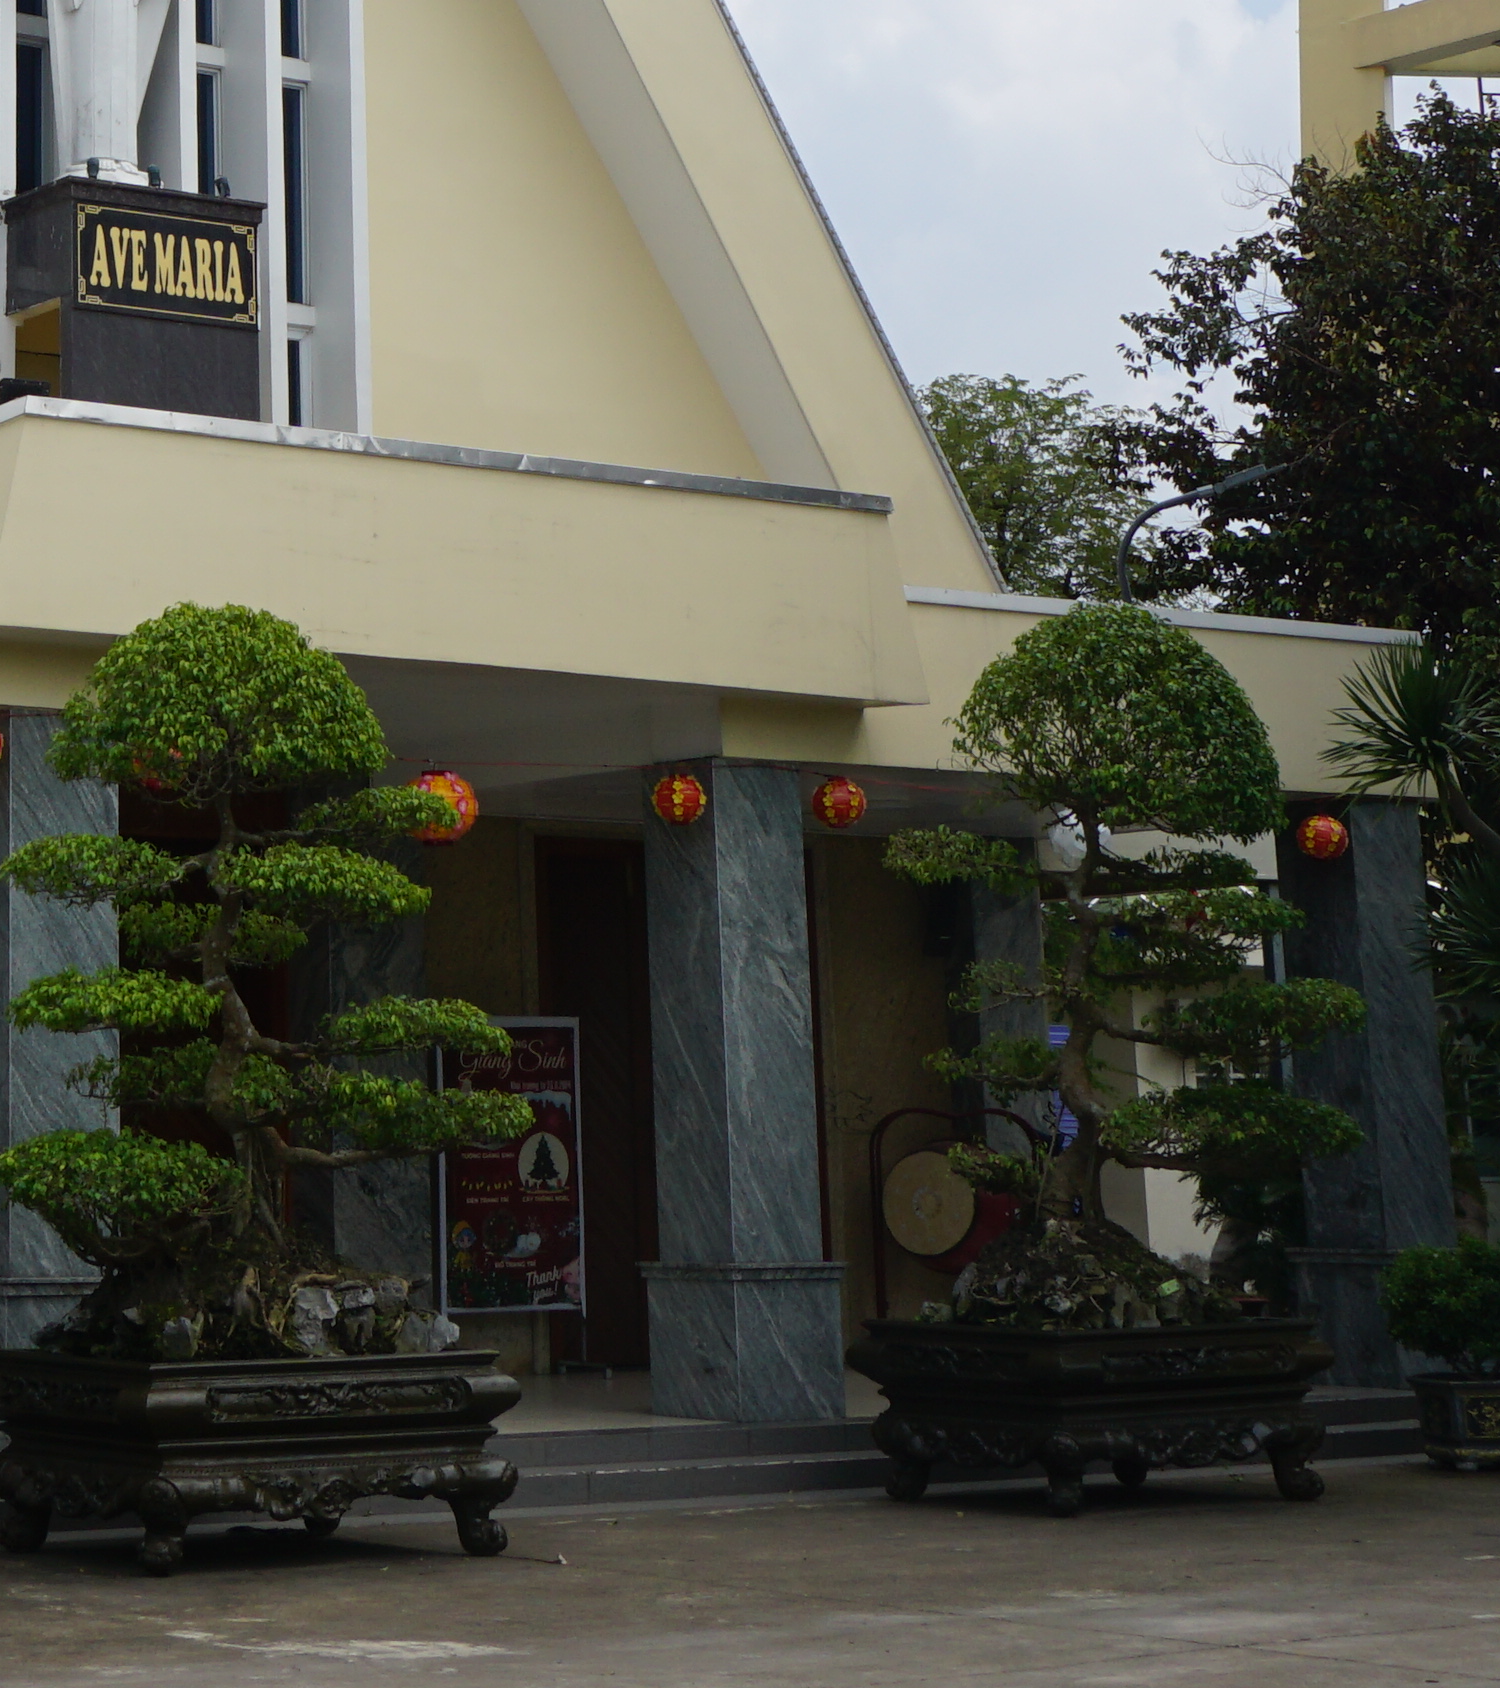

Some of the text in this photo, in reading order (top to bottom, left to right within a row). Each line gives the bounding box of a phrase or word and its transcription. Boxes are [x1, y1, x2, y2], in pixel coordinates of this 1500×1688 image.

[90, 224, 245, 305] AVE MARIA
[518, 1039, 566, 1072] Sinh
[526, 1265, 561, 1288] Thank
